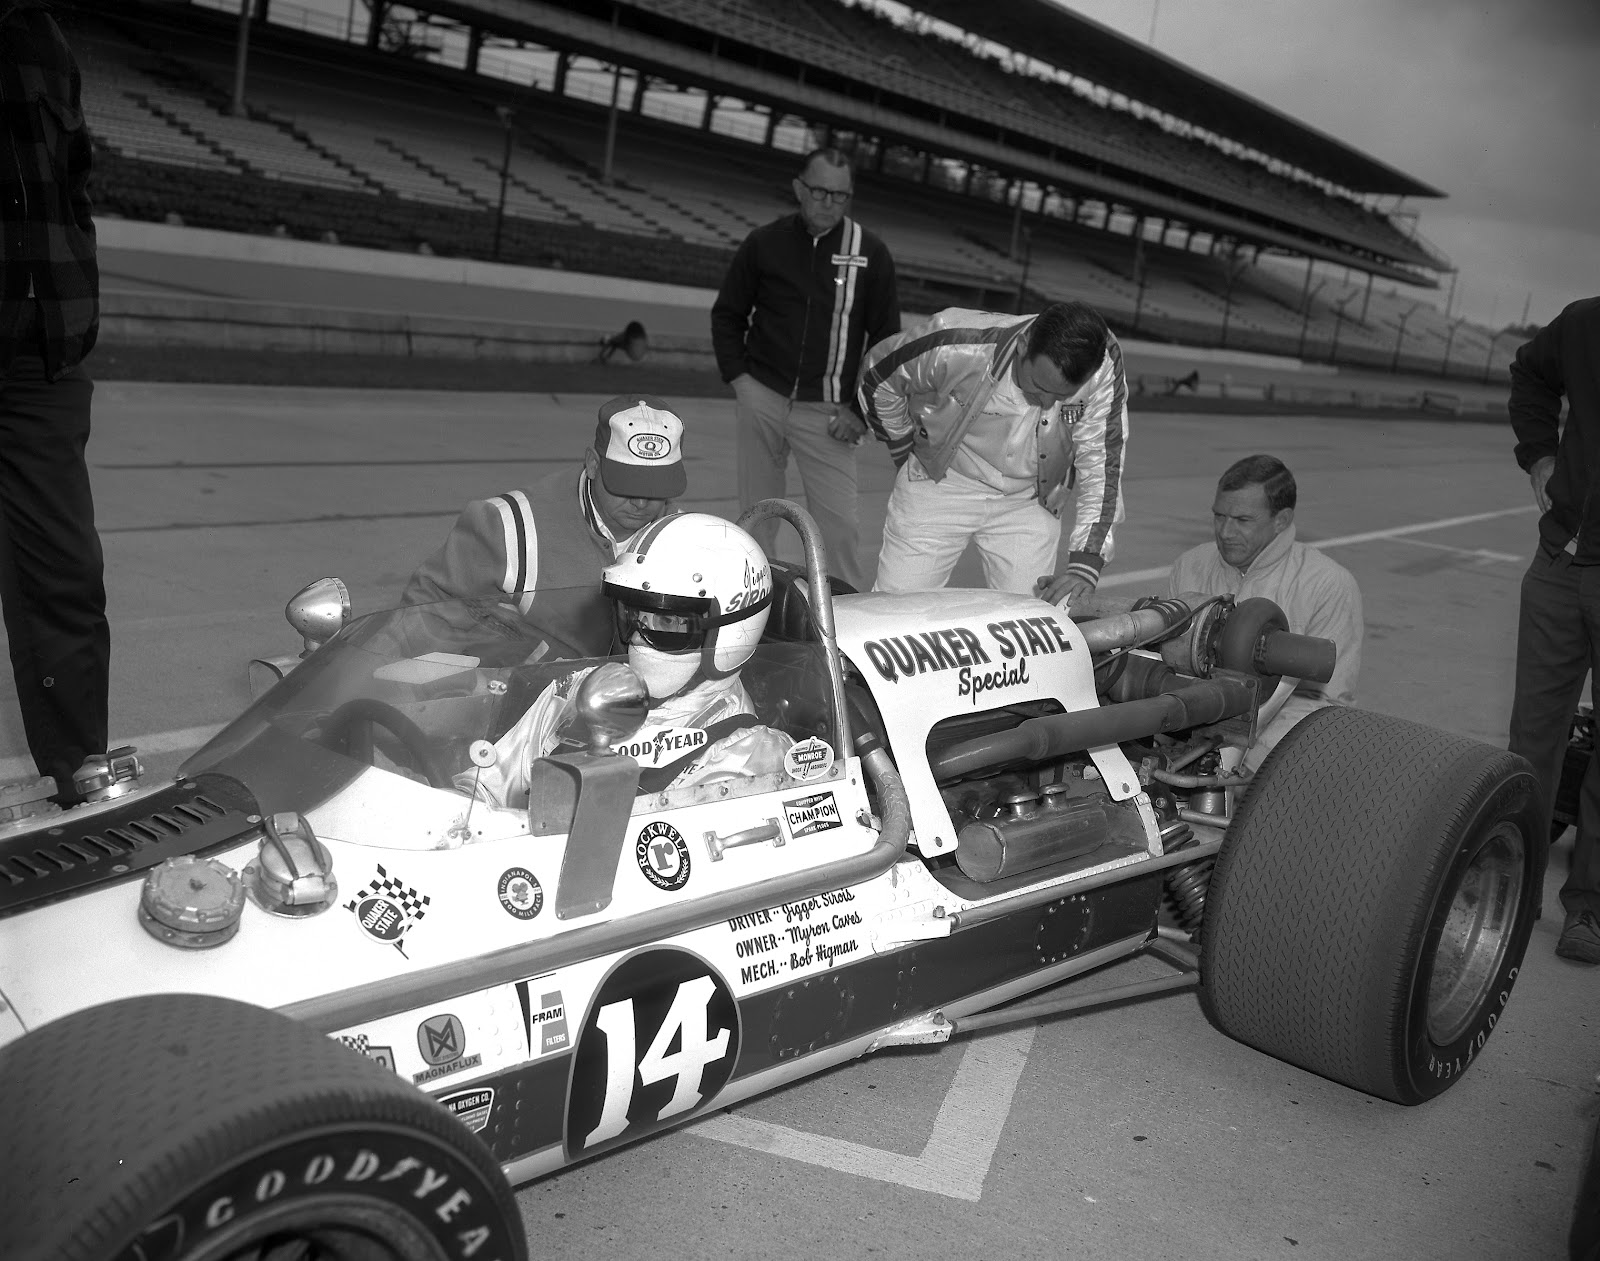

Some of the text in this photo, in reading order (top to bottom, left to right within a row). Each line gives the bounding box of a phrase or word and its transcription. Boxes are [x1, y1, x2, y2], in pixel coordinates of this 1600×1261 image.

[864, 616, 1073, 685] QUAKER STATE
[958, 656, 1030, 706] Special
[797, 751, 823, 762] MONROE
[789, 803, 836, 825] CHAMPION
[637, 822, 688, 868] ROCKWELL
[361, 899, 390, 929] QUAKER
[782, 898, 822, 923] Jigger
[821, 888, 856, 907] Sirois
[374, 908, 398, 935] STATE
[785, 921, 830, 947] Myron
[832, 911, 863, 930] Caves
[790, 947, 814, 970] Bob
[815, 939, 859, 967] Higman
[532, 1007, 562, 1024] FRAM
[546, 1033, 566, 1046] FILTERS
[415, 1056, 479, 1083] MAGNAFLUX
[583, 974, 731, 1149] 14
[457, 1094, 480, 1110] OXYGEN
[480, 1092, 490, 1103] CO.
[206, 1149, 500, 1261] GOODYEA
